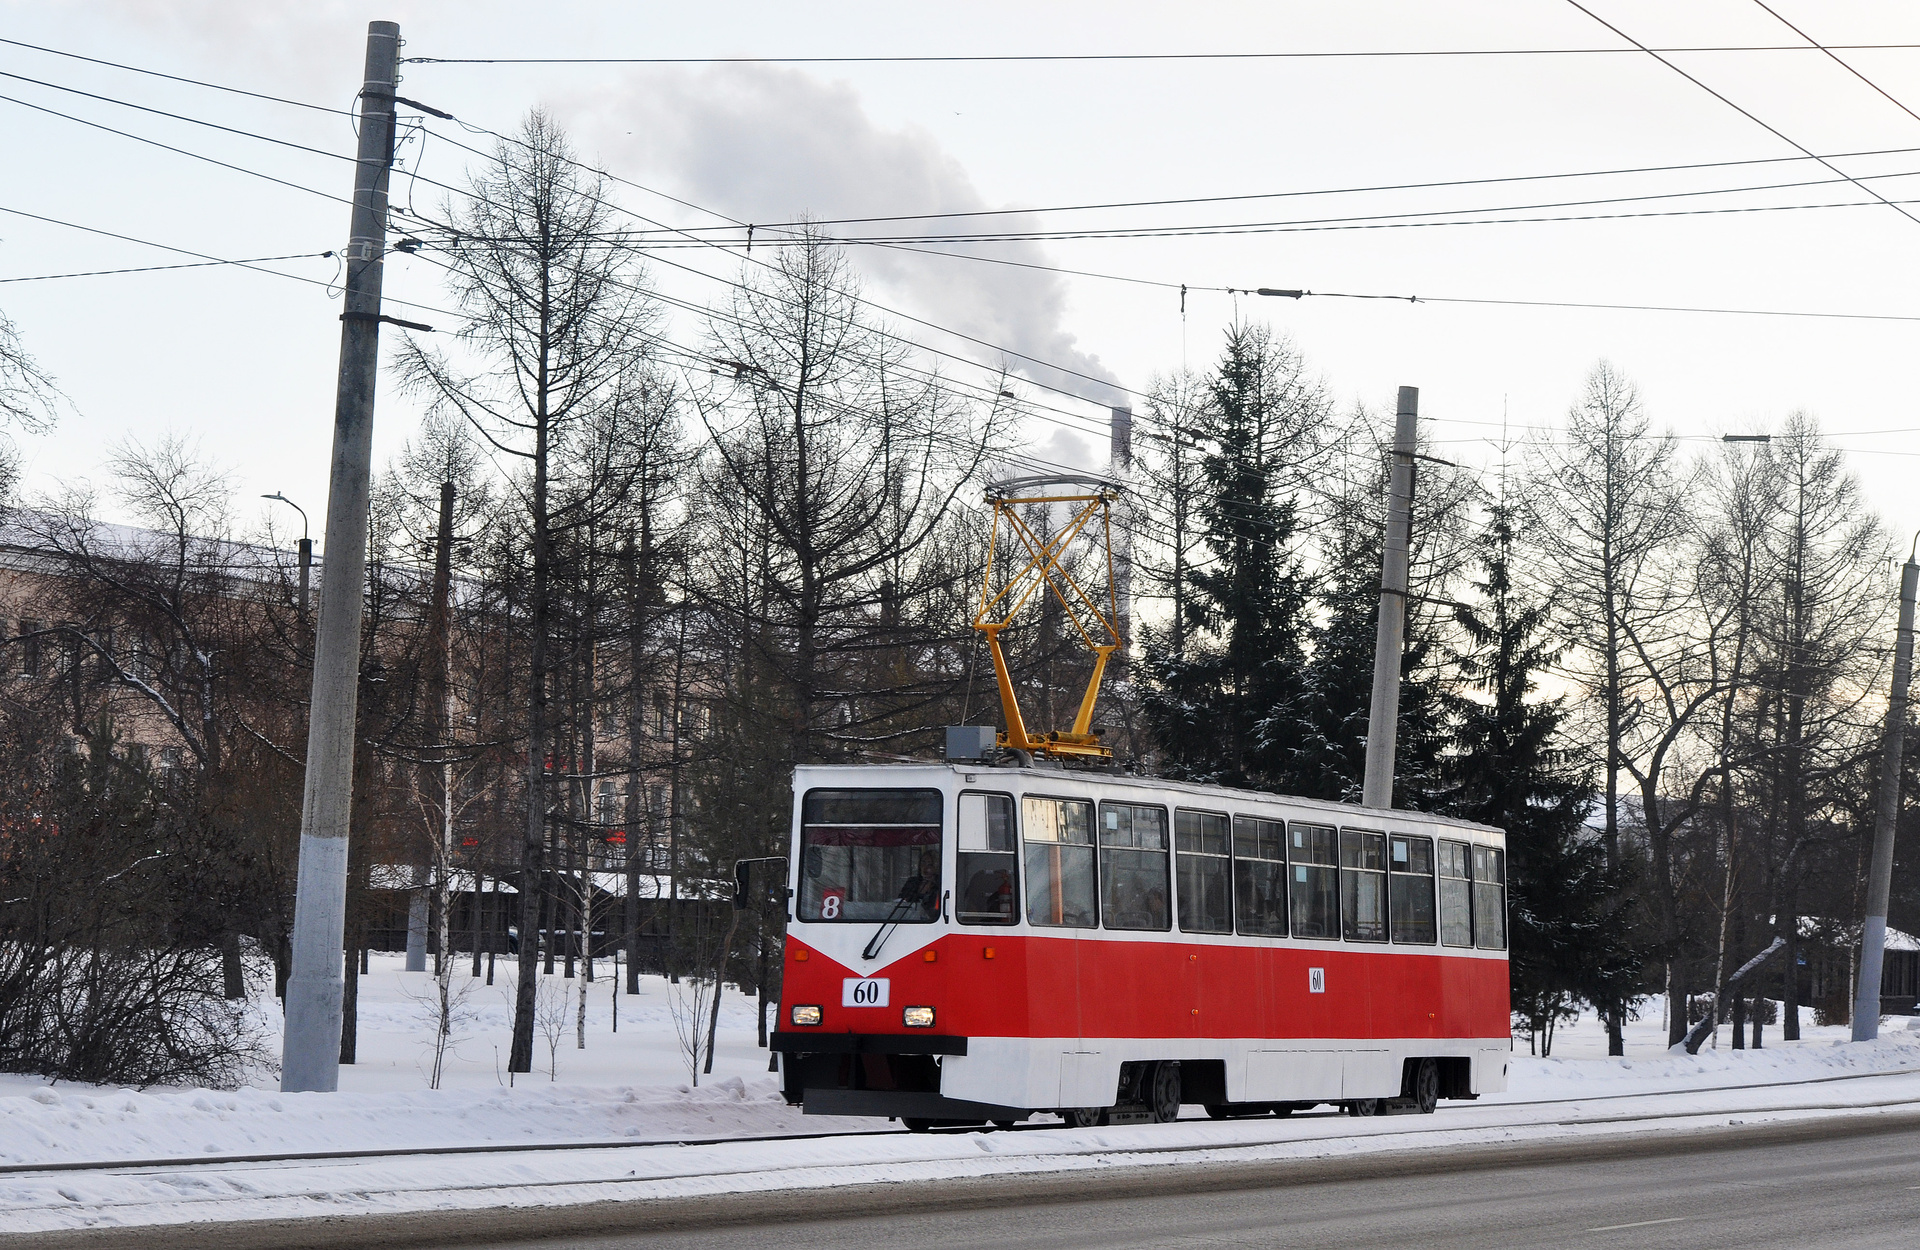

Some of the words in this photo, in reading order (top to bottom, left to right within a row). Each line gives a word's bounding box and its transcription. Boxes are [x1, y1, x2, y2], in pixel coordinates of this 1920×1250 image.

[822, 895, 840, 919] 8
[1312, 970, 1322, 990] 60
[853, 981, 879, 1004] 60
